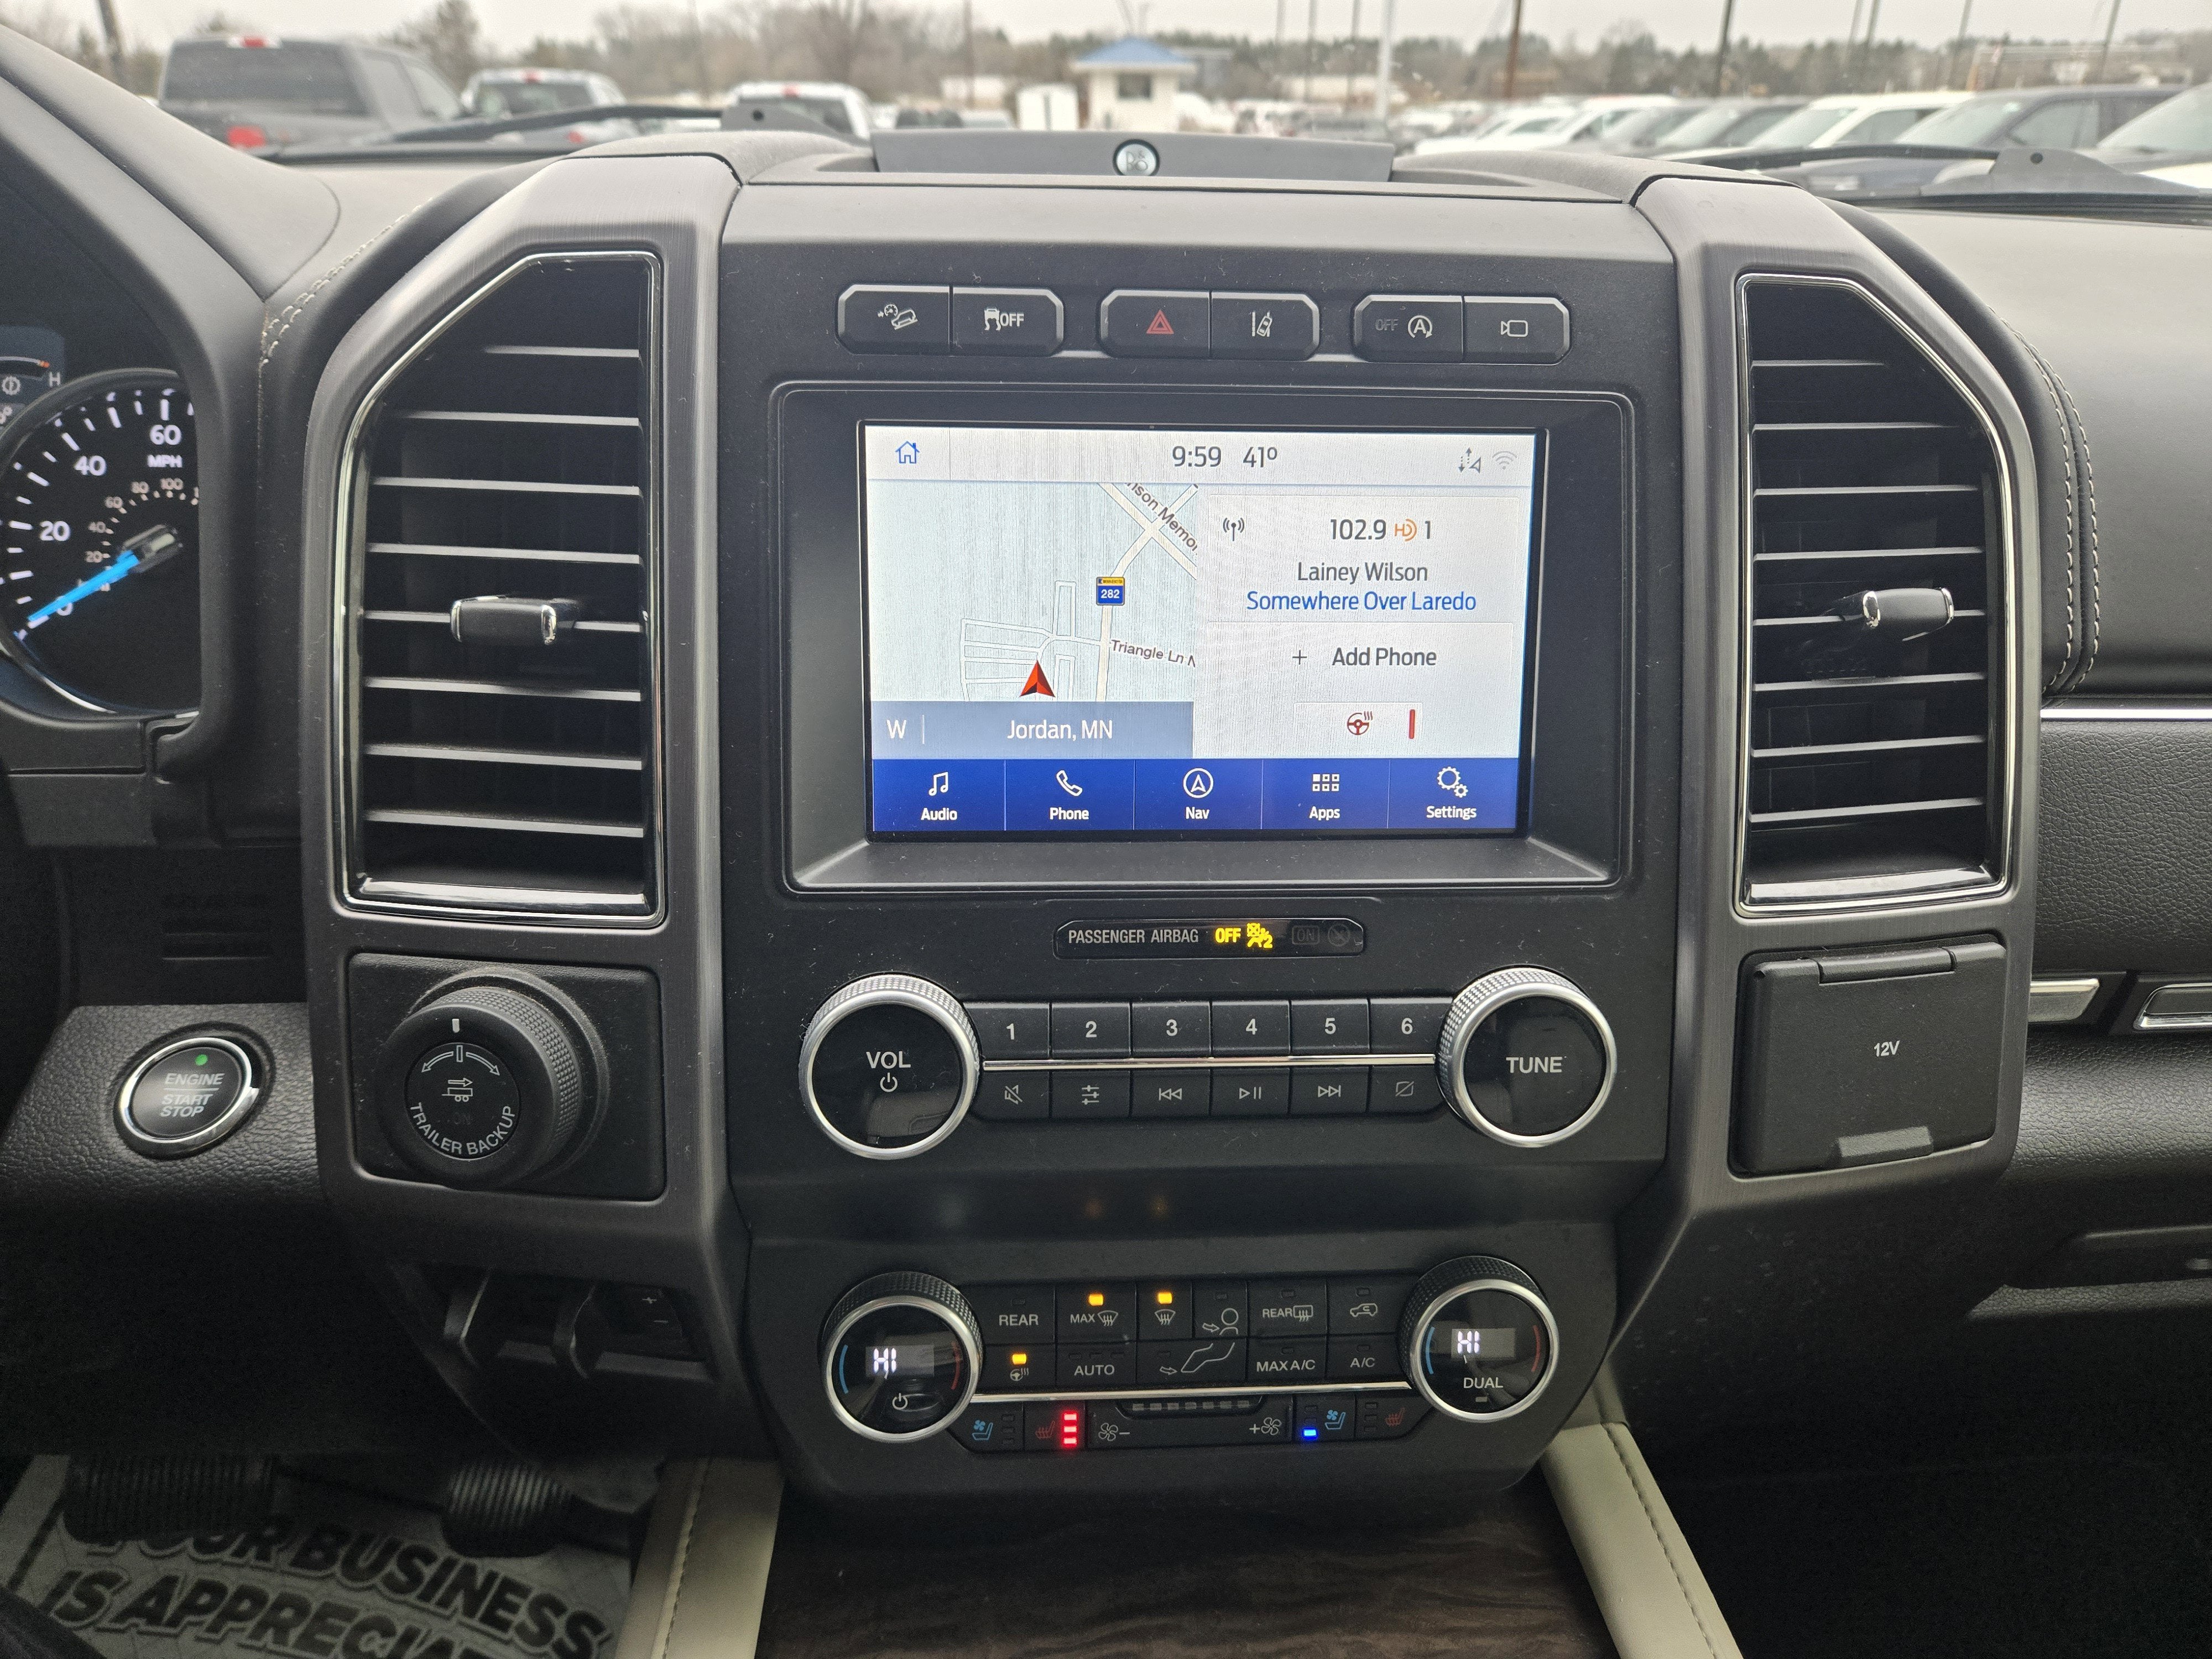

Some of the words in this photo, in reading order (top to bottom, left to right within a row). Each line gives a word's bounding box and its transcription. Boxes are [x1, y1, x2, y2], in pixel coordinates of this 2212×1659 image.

[999, 312, 1024, 327] OFF
[1375, 319, 1399, 331] OFF
[49, 371, 61, 387] H
[149, 424, 181, 445] 60
[147, 455, 182, 468] MPH
[1172, 446, 1222, 467] 9:59
[74, 455, 106, 476] 40
[160, 478, 184, 490] 100
[40, 520, 70, 541] 20
[1330, 519, 1386, 540] 102.9
[1425, 520, 1431, 540] 1
[1297, 561, 1360, 585] Lainey
[1364, 561, 1428, 581] Wilson
[1101, 589, 1120, 599] 282
[1246, 591, 1359, 610] Somewhere
[1364, 591, 1407, 611] Over
[1411, 591, 1477, 611] Laredo
[1111, 639, 1164, 660] Triangle
[1168, 650, 1184, 664] Ln
[1332, 647, 1370, 666] Add
[1375, 647, 1437, 666] Phone
[886, 719, 907, 739] W
[1007, 719, 1077, 742] Jordan,
[1082, 719, 1113, 739] MN
[920, 807, 958, 821] Audio
[1050, 807, 1089, 820] Phone
[1186, 806, 1210, 820] Nav
[1309, 806, 1340, 821] Apps
[1426, 805, 1477, 821] Settings
[1068, 929, 1145, 943] PASSENGER
[1150, 928, 1199, 943] AIRBAG
[1215, 927, 1241, 943] OFF
[1006, 1023, 1015, 1040] 1
[1086, 1020, 1097, 1038] 2
[1166, 1019, 1178, 1036] 3
[1245, 1018, 1258, 1035] 4
[1324, 1017, 1336, 1035] 5
[1401, 1018, 1413, 1035] 6
[1874, 1040, 1900, 1057] 12V
[866, 1051, 911, 1069] VOL
[1506, 1056, 1562, 1074] TUNE
[165, 1072, 226, 1086] ENGINE
[160, 1093, 215, 1106] START
[159, 1105, 205, 1118] STOP
[409, 1102, 463, 1156] TRAILER
[466, 1105, 517, 1157] BACKUP
[999, 1313, 1039, 1326] REAR
[1070, 1313, 1096, 1323] MAX
[1262, 1307, 1293, 1318] REAR
[1457, 1331, 1480, 1353] HI
[873, 1348, 897, 1373] HI
[1256, 1360, 1288, 1372] MAX
[1290, 1359, 1316, 1370] A/C
[1350, 1357, 1375, 1368] A/C
[1074, 1364, 1115, 1376] AUTO
[1463, 1376, 1504, 1389] DUAL
[288, 1521, 608, 1659] BUSINESS
[111, 1574, 484, 1659] APPRECI
